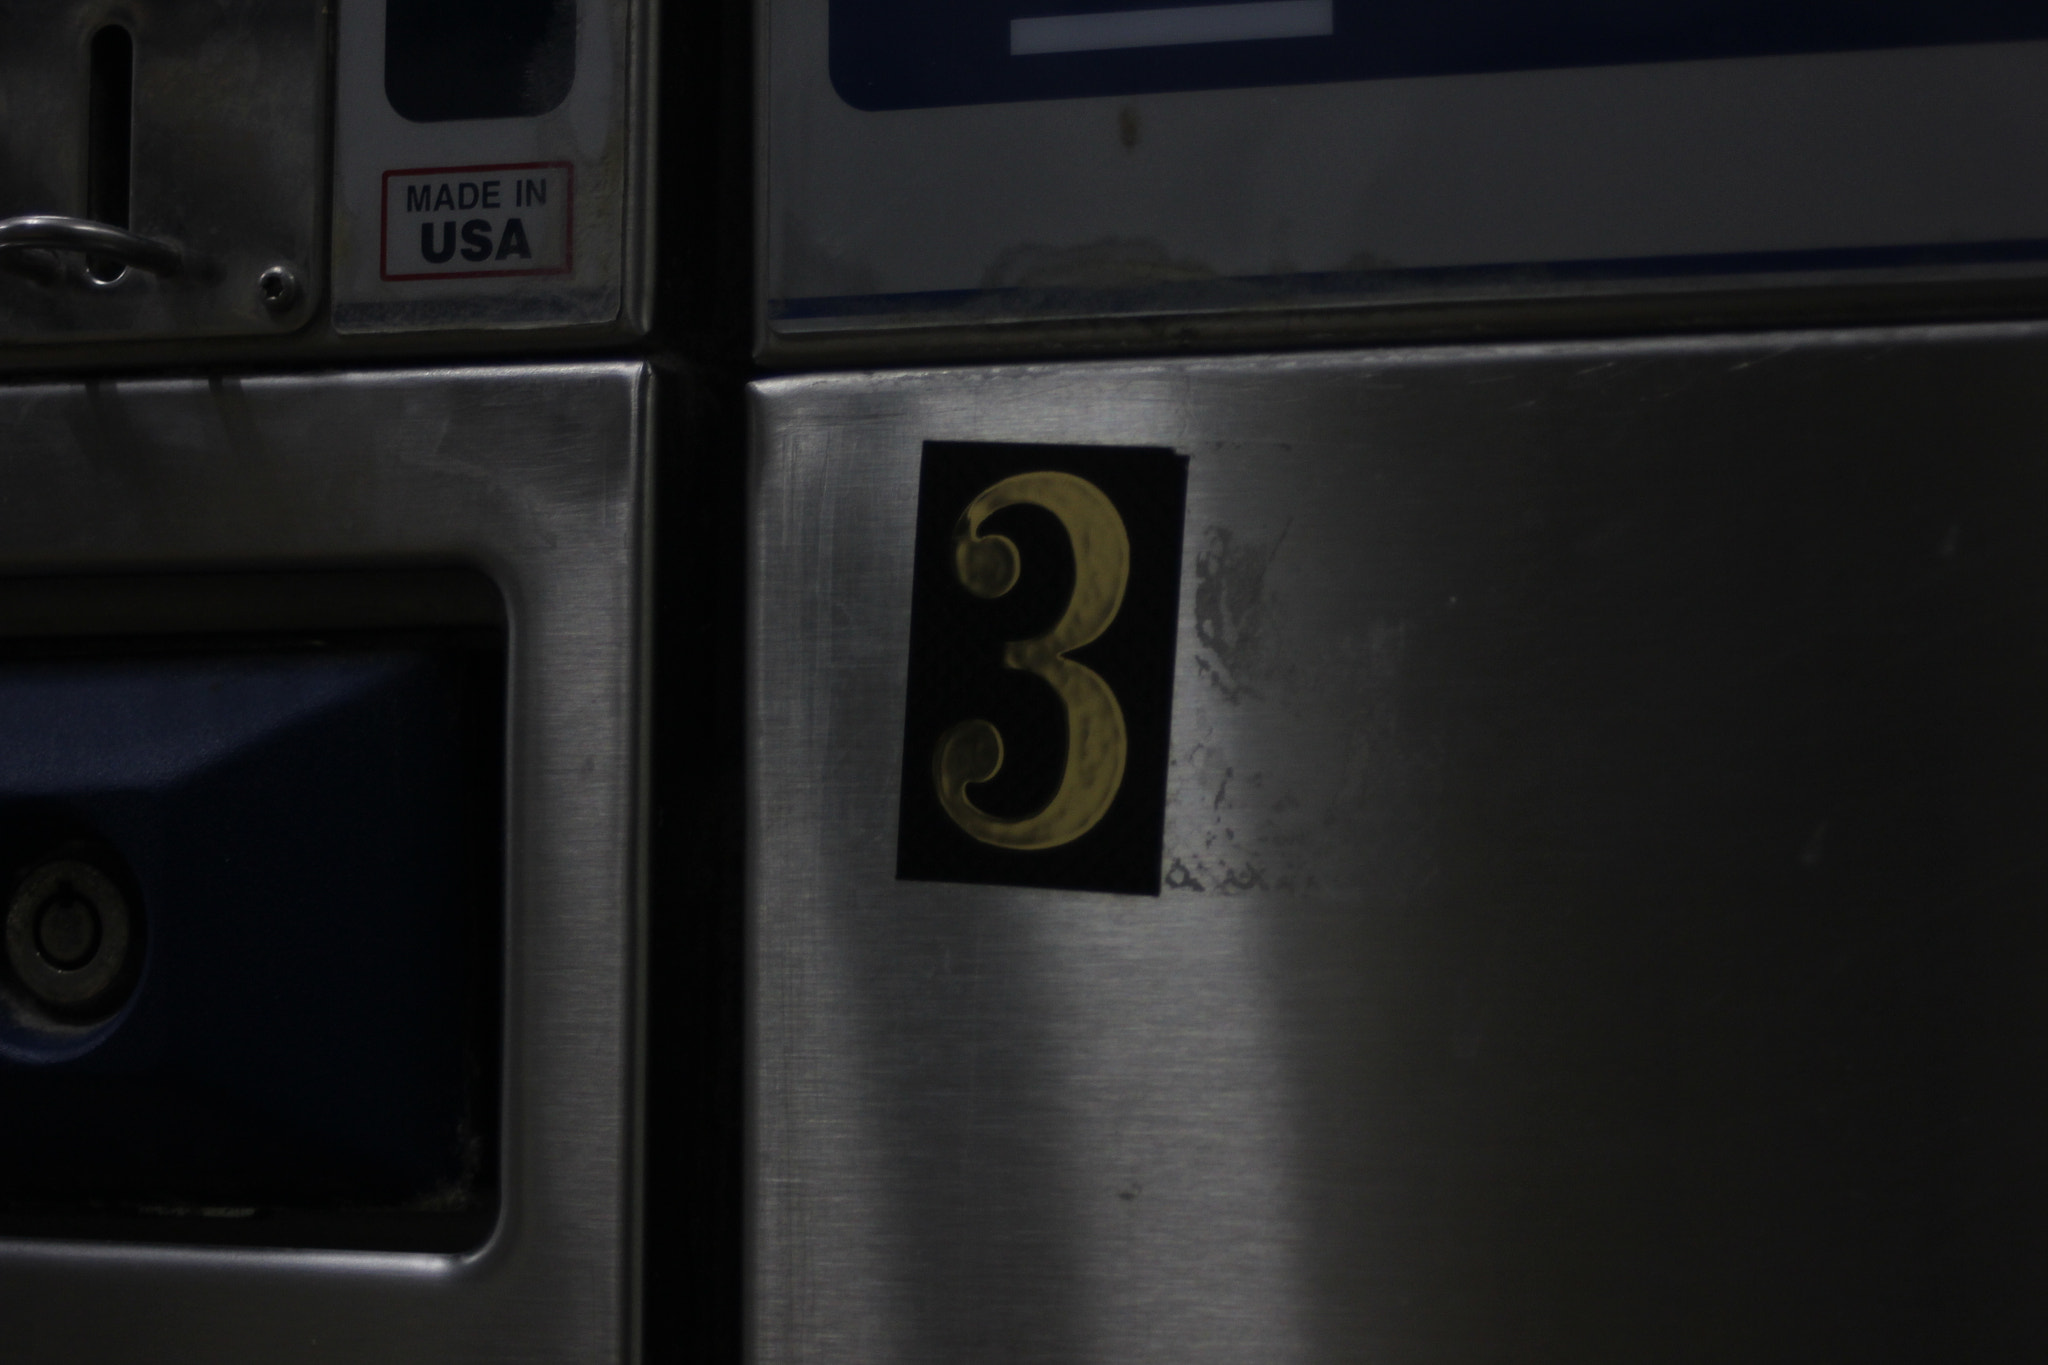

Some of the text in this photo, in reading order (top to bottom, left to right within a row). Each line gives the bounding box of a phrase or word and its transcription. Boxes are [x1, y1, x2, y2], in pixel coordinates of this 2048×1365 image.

[407, 178, 546, 212] MADE IN
[421, 218, 532, 263] USA
[931, 470, 1131, 850] 3
